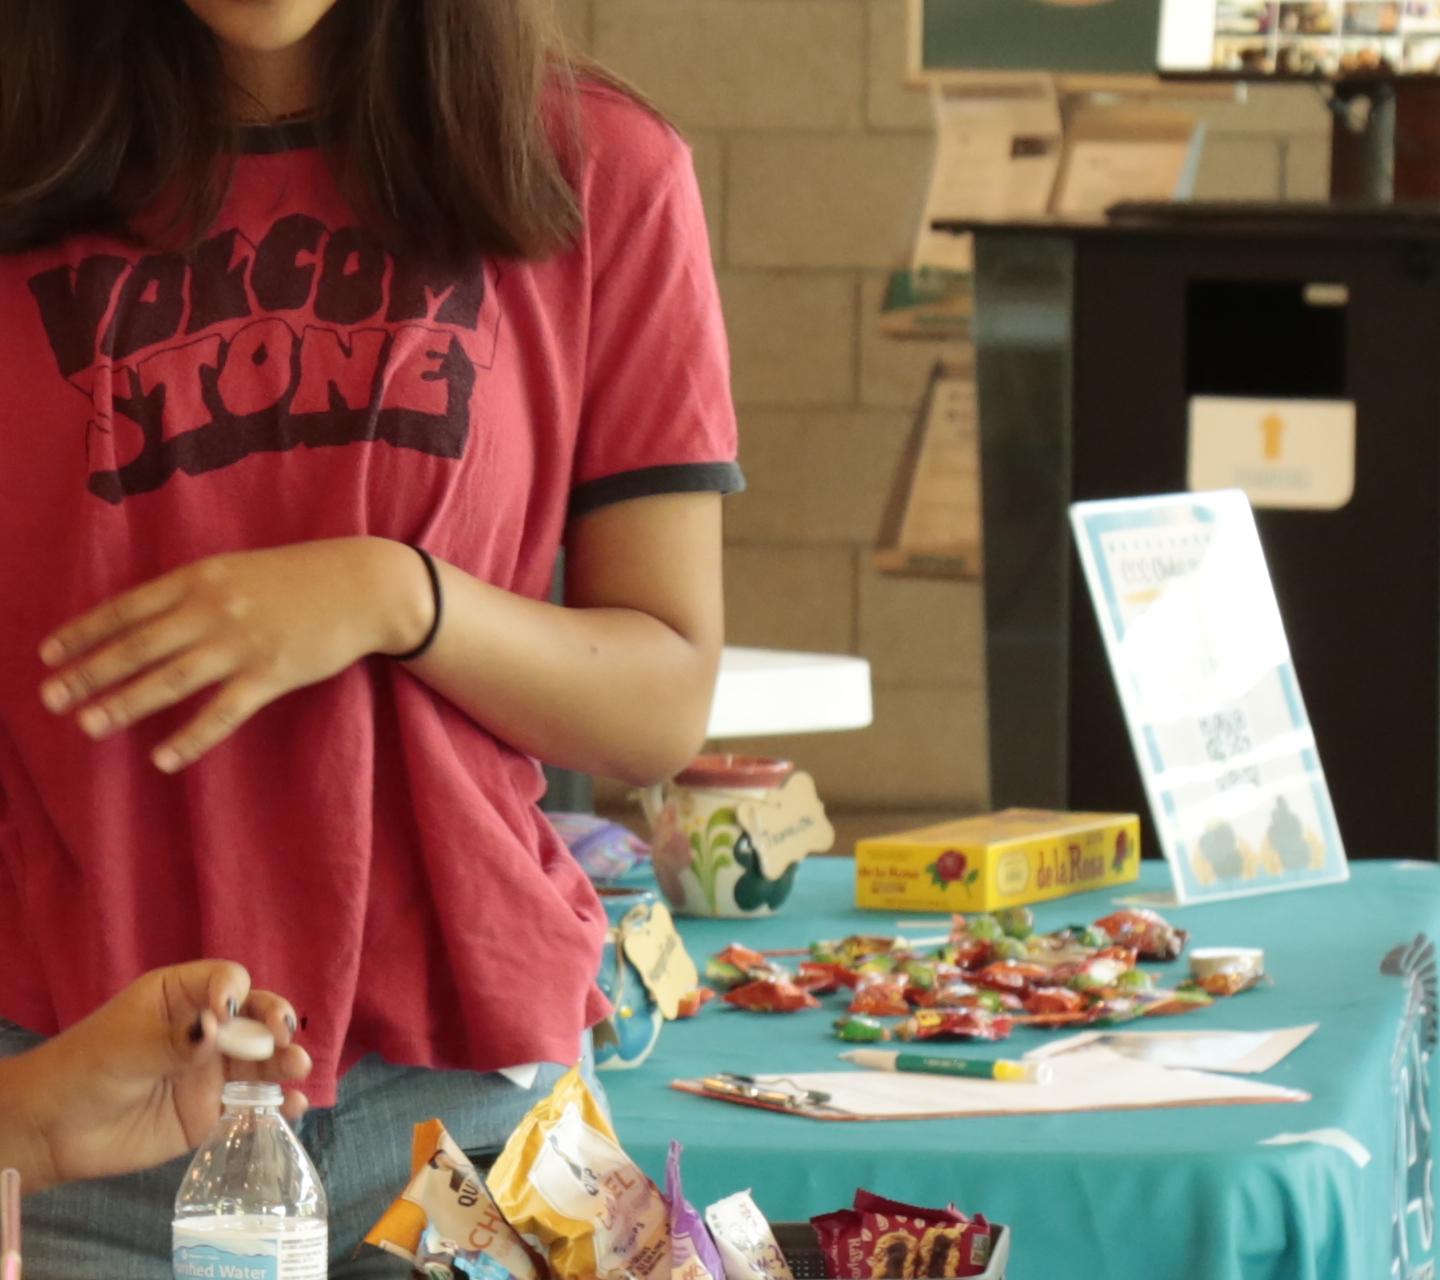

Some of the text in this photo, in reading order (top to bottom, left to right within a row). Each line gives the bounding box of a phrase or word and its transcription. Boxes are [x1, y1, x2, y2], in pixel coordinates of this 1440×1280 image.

[27, 213, 495, 380] VOLCOM
[86, 317, 477, 505] STONE
[1068, 843, 1106, 884] Rosa
[220, 1264, 268, 1280] Water
